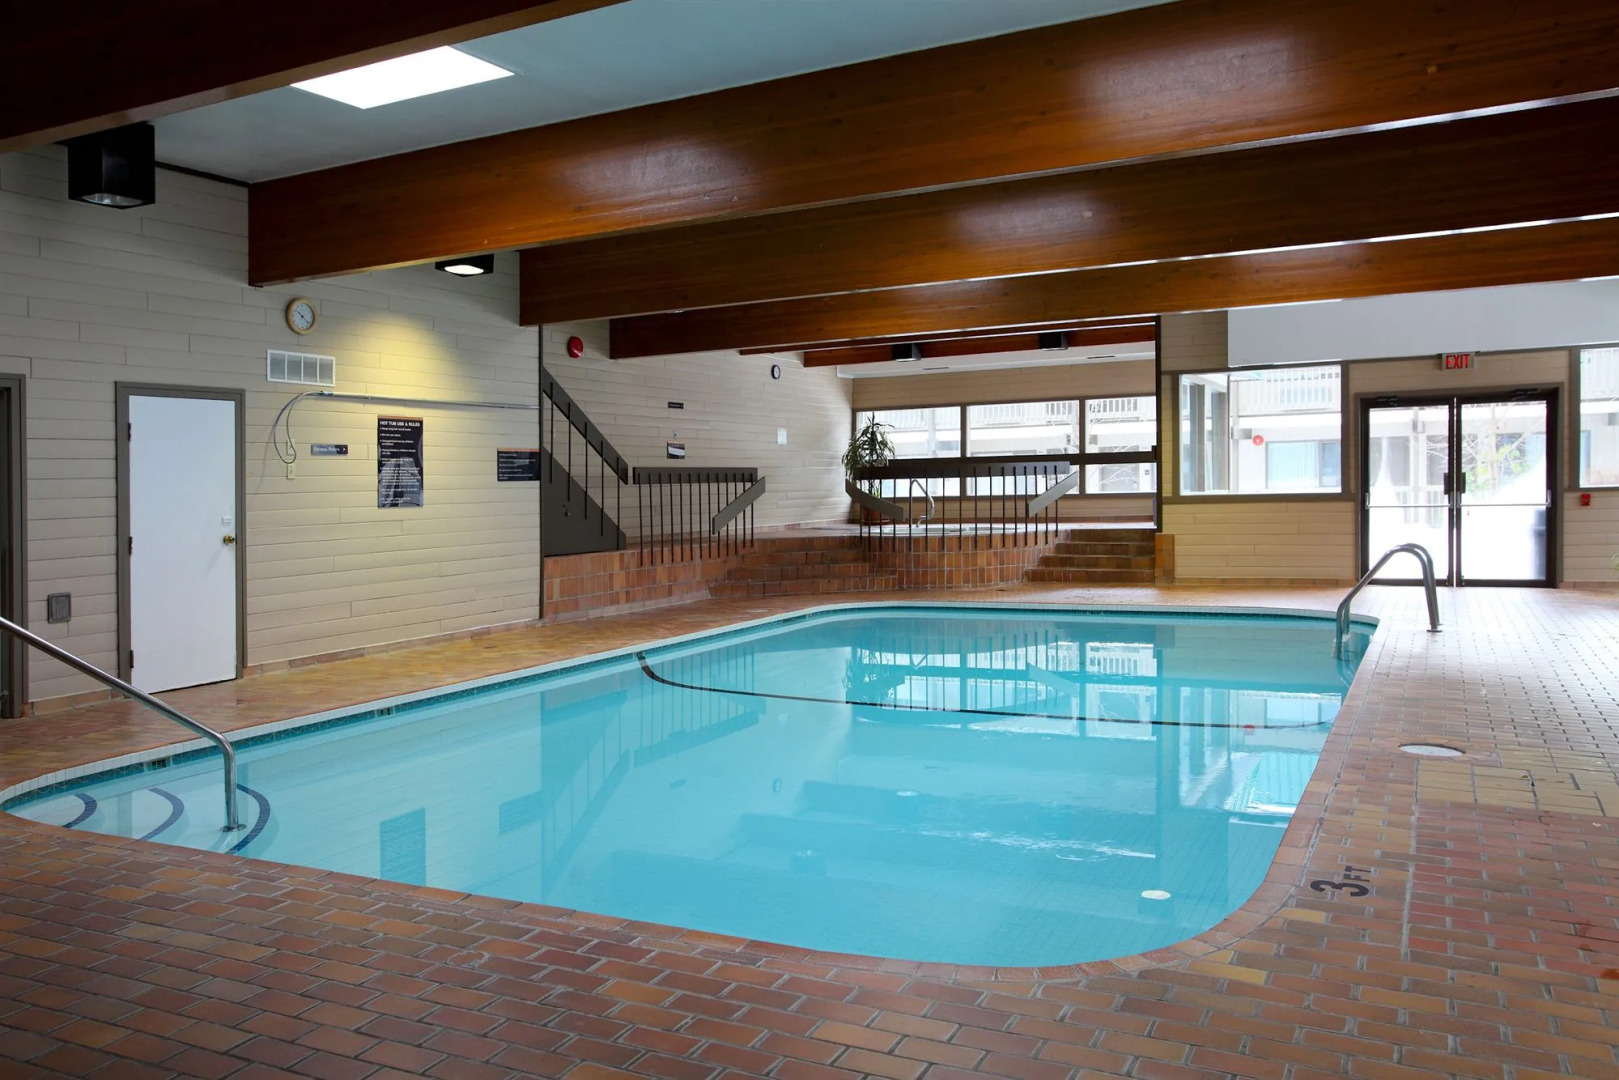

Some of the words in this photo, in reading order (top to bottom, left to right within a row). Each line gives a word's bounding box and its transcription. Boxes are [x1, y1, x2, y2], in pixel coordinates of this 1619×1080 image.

[1445, 354, 1470, 369] EXIT
[1310, 880, 1369, 897] 3
[1343, 865, 1372, 882] FT
